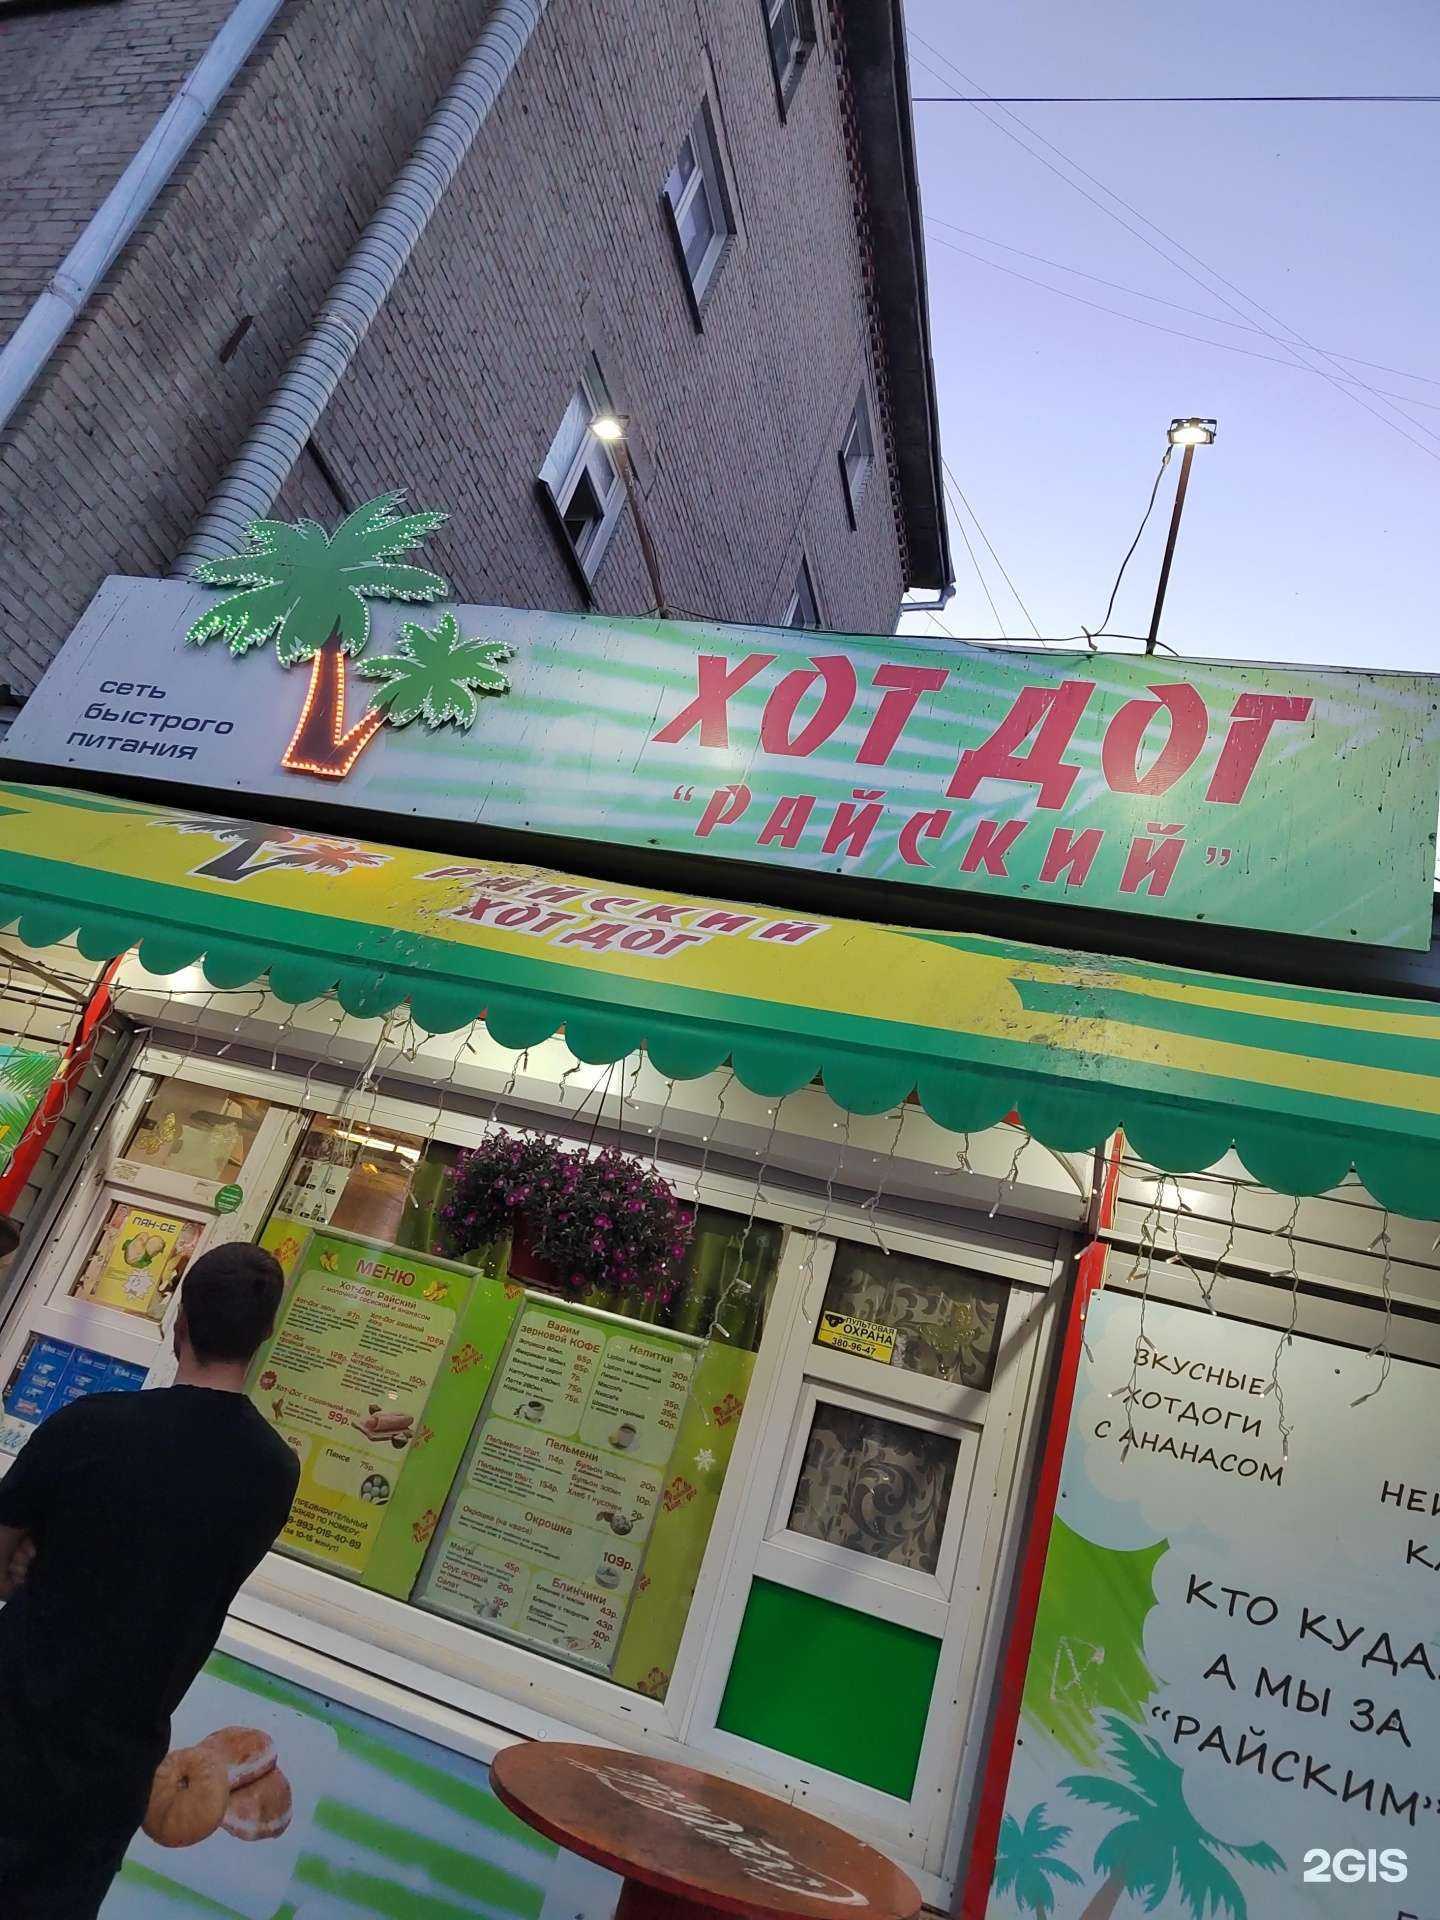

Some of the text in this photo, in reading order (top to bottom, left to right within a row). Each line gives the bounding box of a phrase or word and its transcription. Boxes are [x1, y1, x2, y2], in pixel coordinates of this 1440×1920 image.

[99, 677, 167, 700] сеть
[83, 702, 234, 736] быстрого
[651, 653, 1315, 810] ХОТ ДОГ
[66, 730, 198, 762] питания
[452, 897, 704, 955] ХОТ ДОГ
[354, 1259, 417, 1286] МЕНЮ
[338, 1281, 417, 1308] Хот-Дог Райский
[547, 1320, 580, 1335] Варим
[843, 1324, 893, 1345] ОХРАНА
[845, 1317, 895, 1334] ПУЛЬТОВАЯ
[570, 1339, 600, 1352] КОФЕ
[629, 1344, 673, 1363] Напитки
[831, 1337, 877, 1355] 380-96-47
[1133, 1347, 1267, 1396] ВКУСНЫЕ
[326, 1410, 352, 1426] 99р.
[1123, 1387, 1262, 1438] ХОТДОГИ
[545, 1438, 599, 1461] Пельмени
[1094, 1419, 1285, 1487] С АНАНАСОМ
[524, 1511, 573, 1536] Окрошка
[603, 1552, 634, 1572] 109р.
[1406, 1539, 1440, 1572] К
[552, 1578, 606, 1605] Блинчики
[1186, 1574, 1279, 1626] КТО
[1203, 1654, 1411, 1748] А МЫ ЗА
